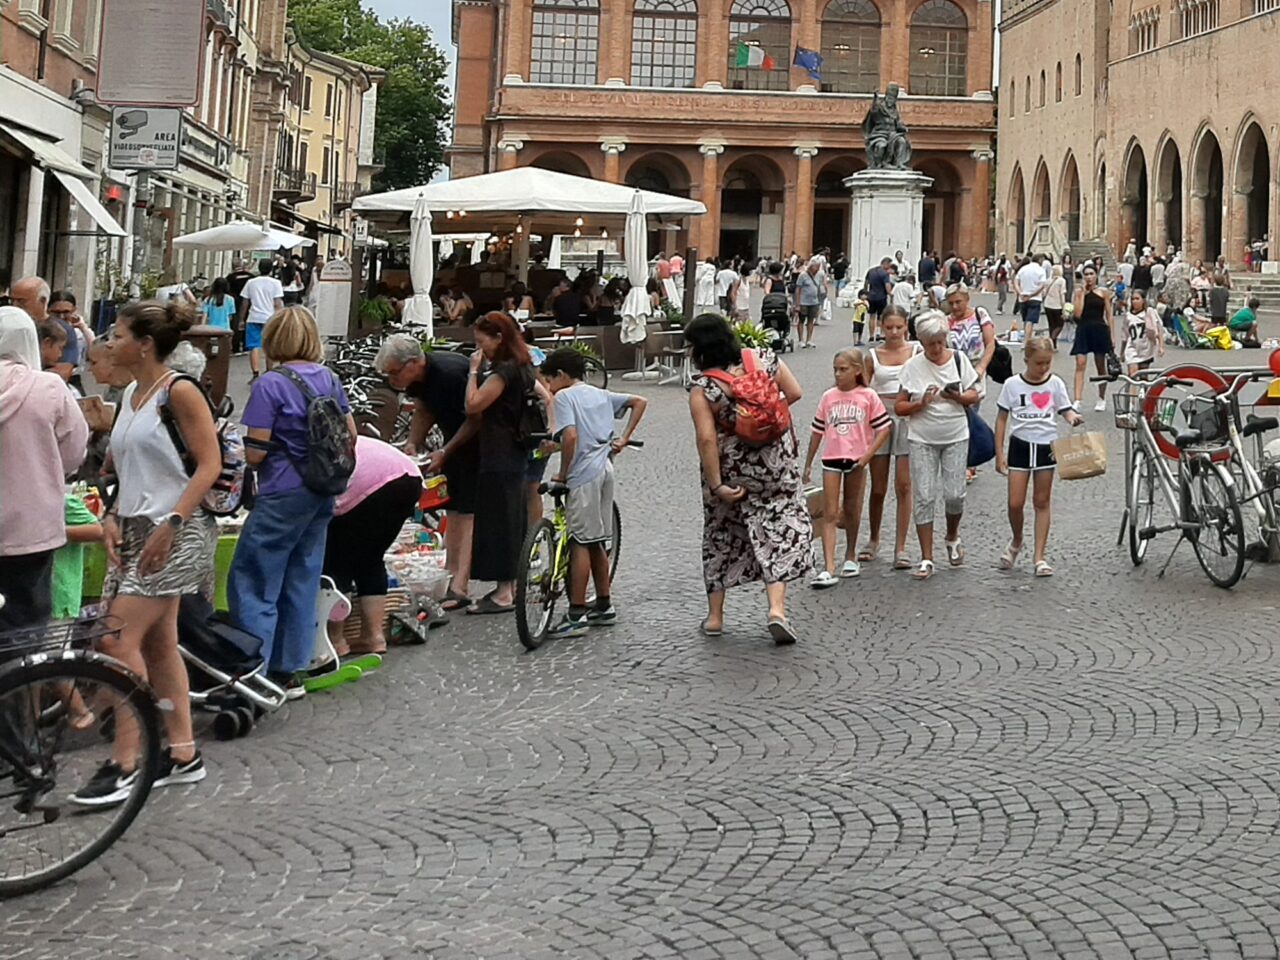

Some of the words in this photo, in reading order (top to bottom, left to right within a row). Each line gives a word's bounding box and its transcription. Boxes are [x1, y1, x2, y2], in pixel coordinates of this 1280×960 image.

[154, 132, 176, 142] AREA
[1129, 322, 1146, 341] 07
[1019, 393, 1027, 407] I
